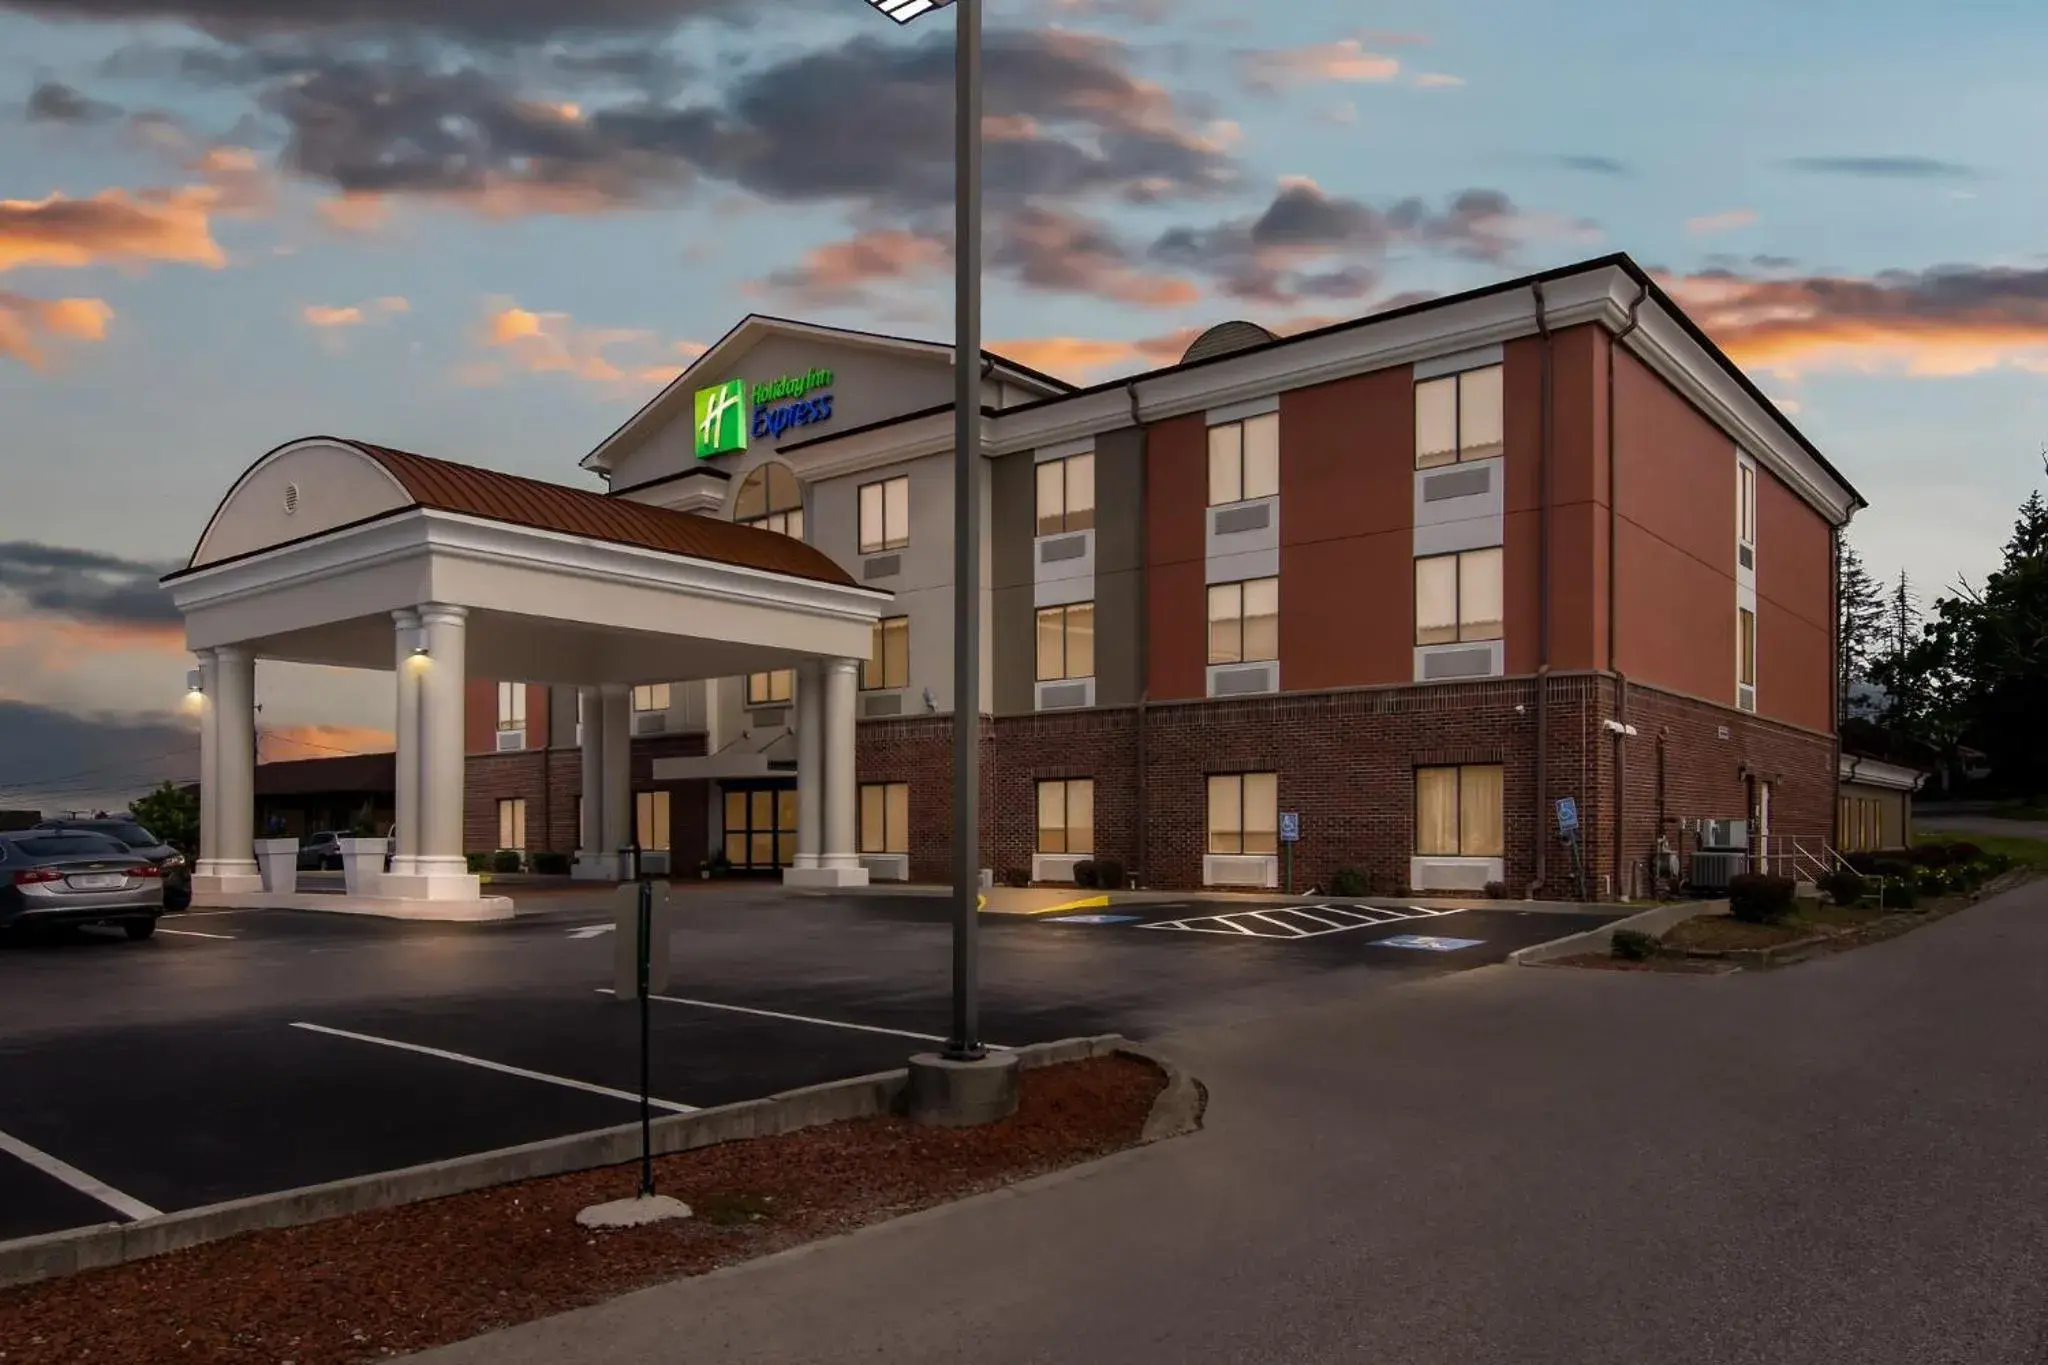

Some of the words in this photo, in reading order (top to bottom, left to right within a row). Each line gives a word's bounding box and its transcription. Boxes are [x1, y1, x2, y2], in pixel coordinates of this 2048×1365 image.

[752, 375, 806, 404] Holiday
[806, 367, 833, 389] Inn
[699, 385, 739, 449] H
[752, 394, 834, 440] Express
